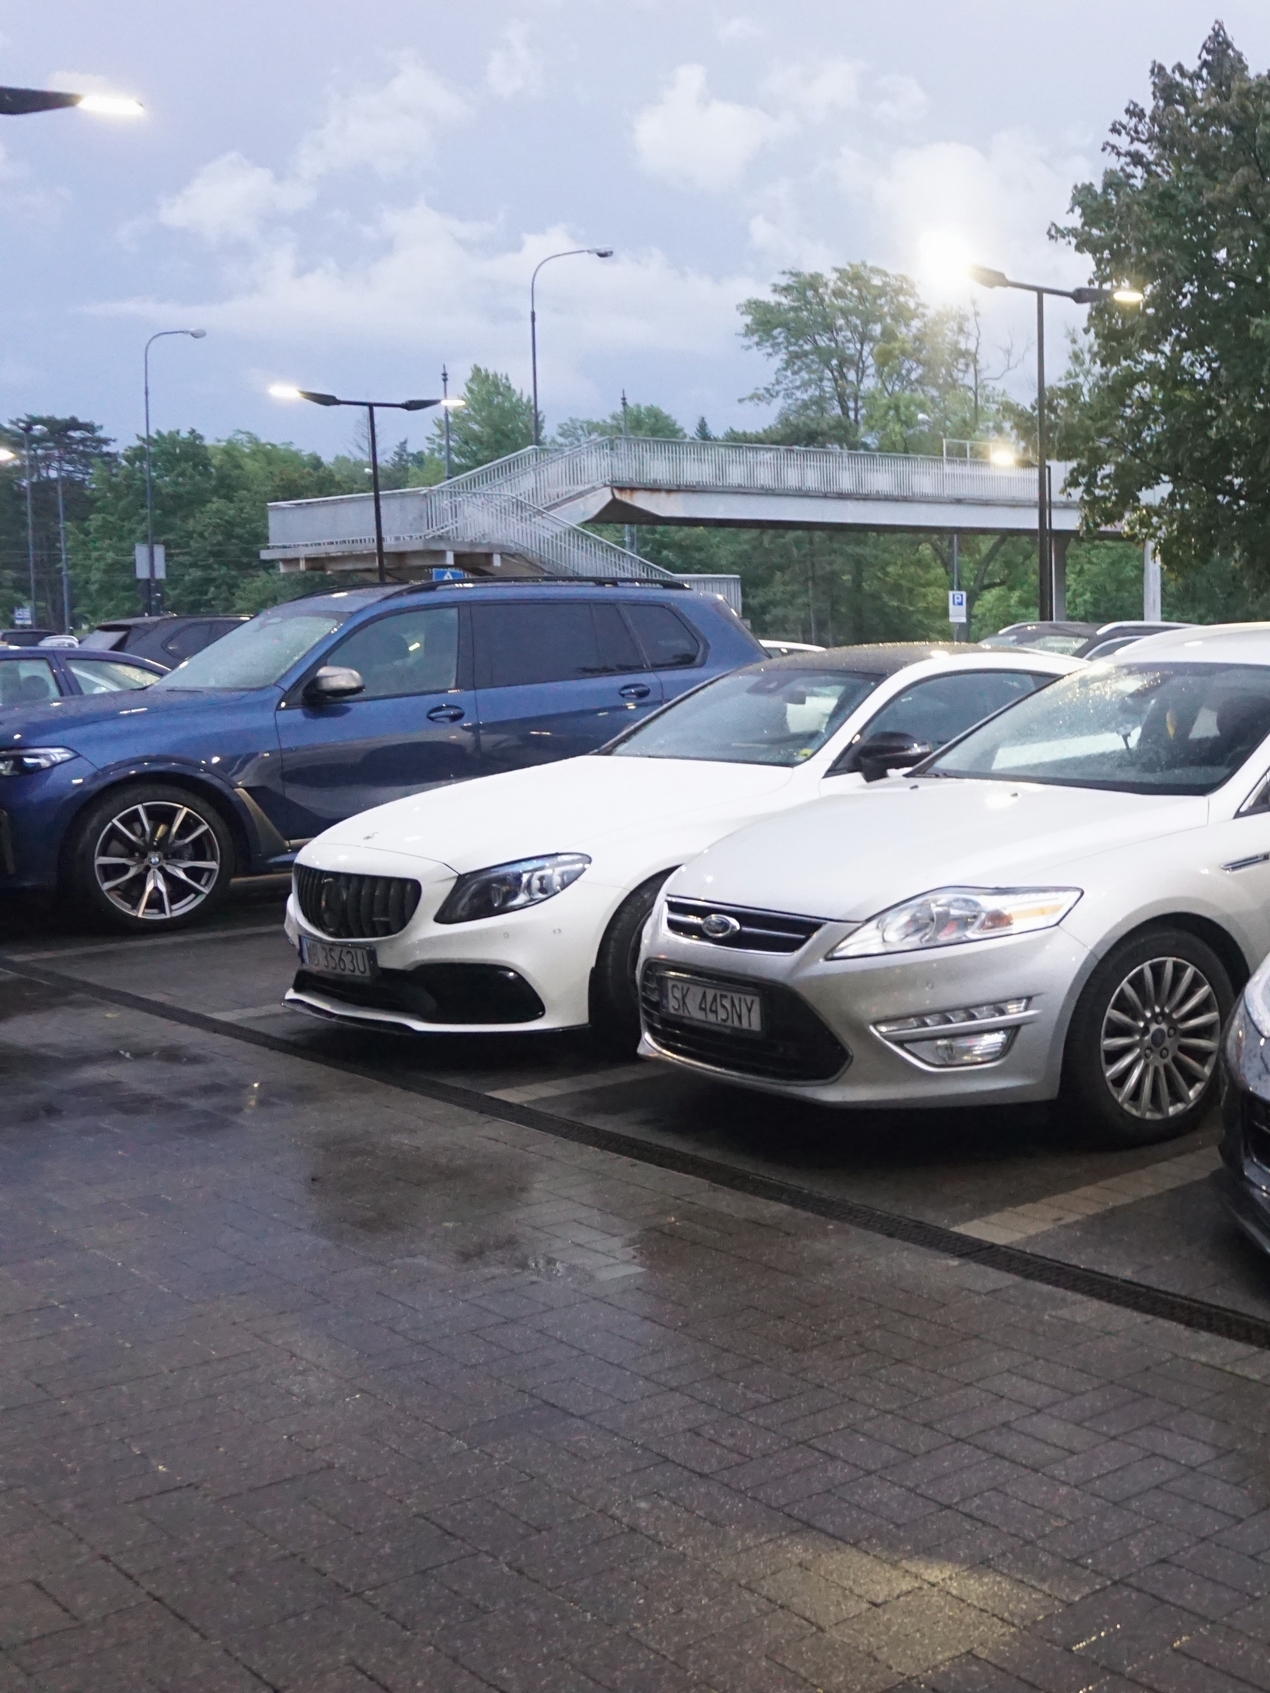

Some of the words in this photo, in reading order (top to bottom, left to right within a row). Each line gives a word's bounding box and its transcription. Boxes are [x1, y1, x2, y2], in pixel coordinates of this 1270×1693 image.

[954, 594, 962, 605] P
[322, 946, 367, 975] 3563U
[671, 984, 691, 1015] SK
[698, 990, 755, 1028] 445NY
